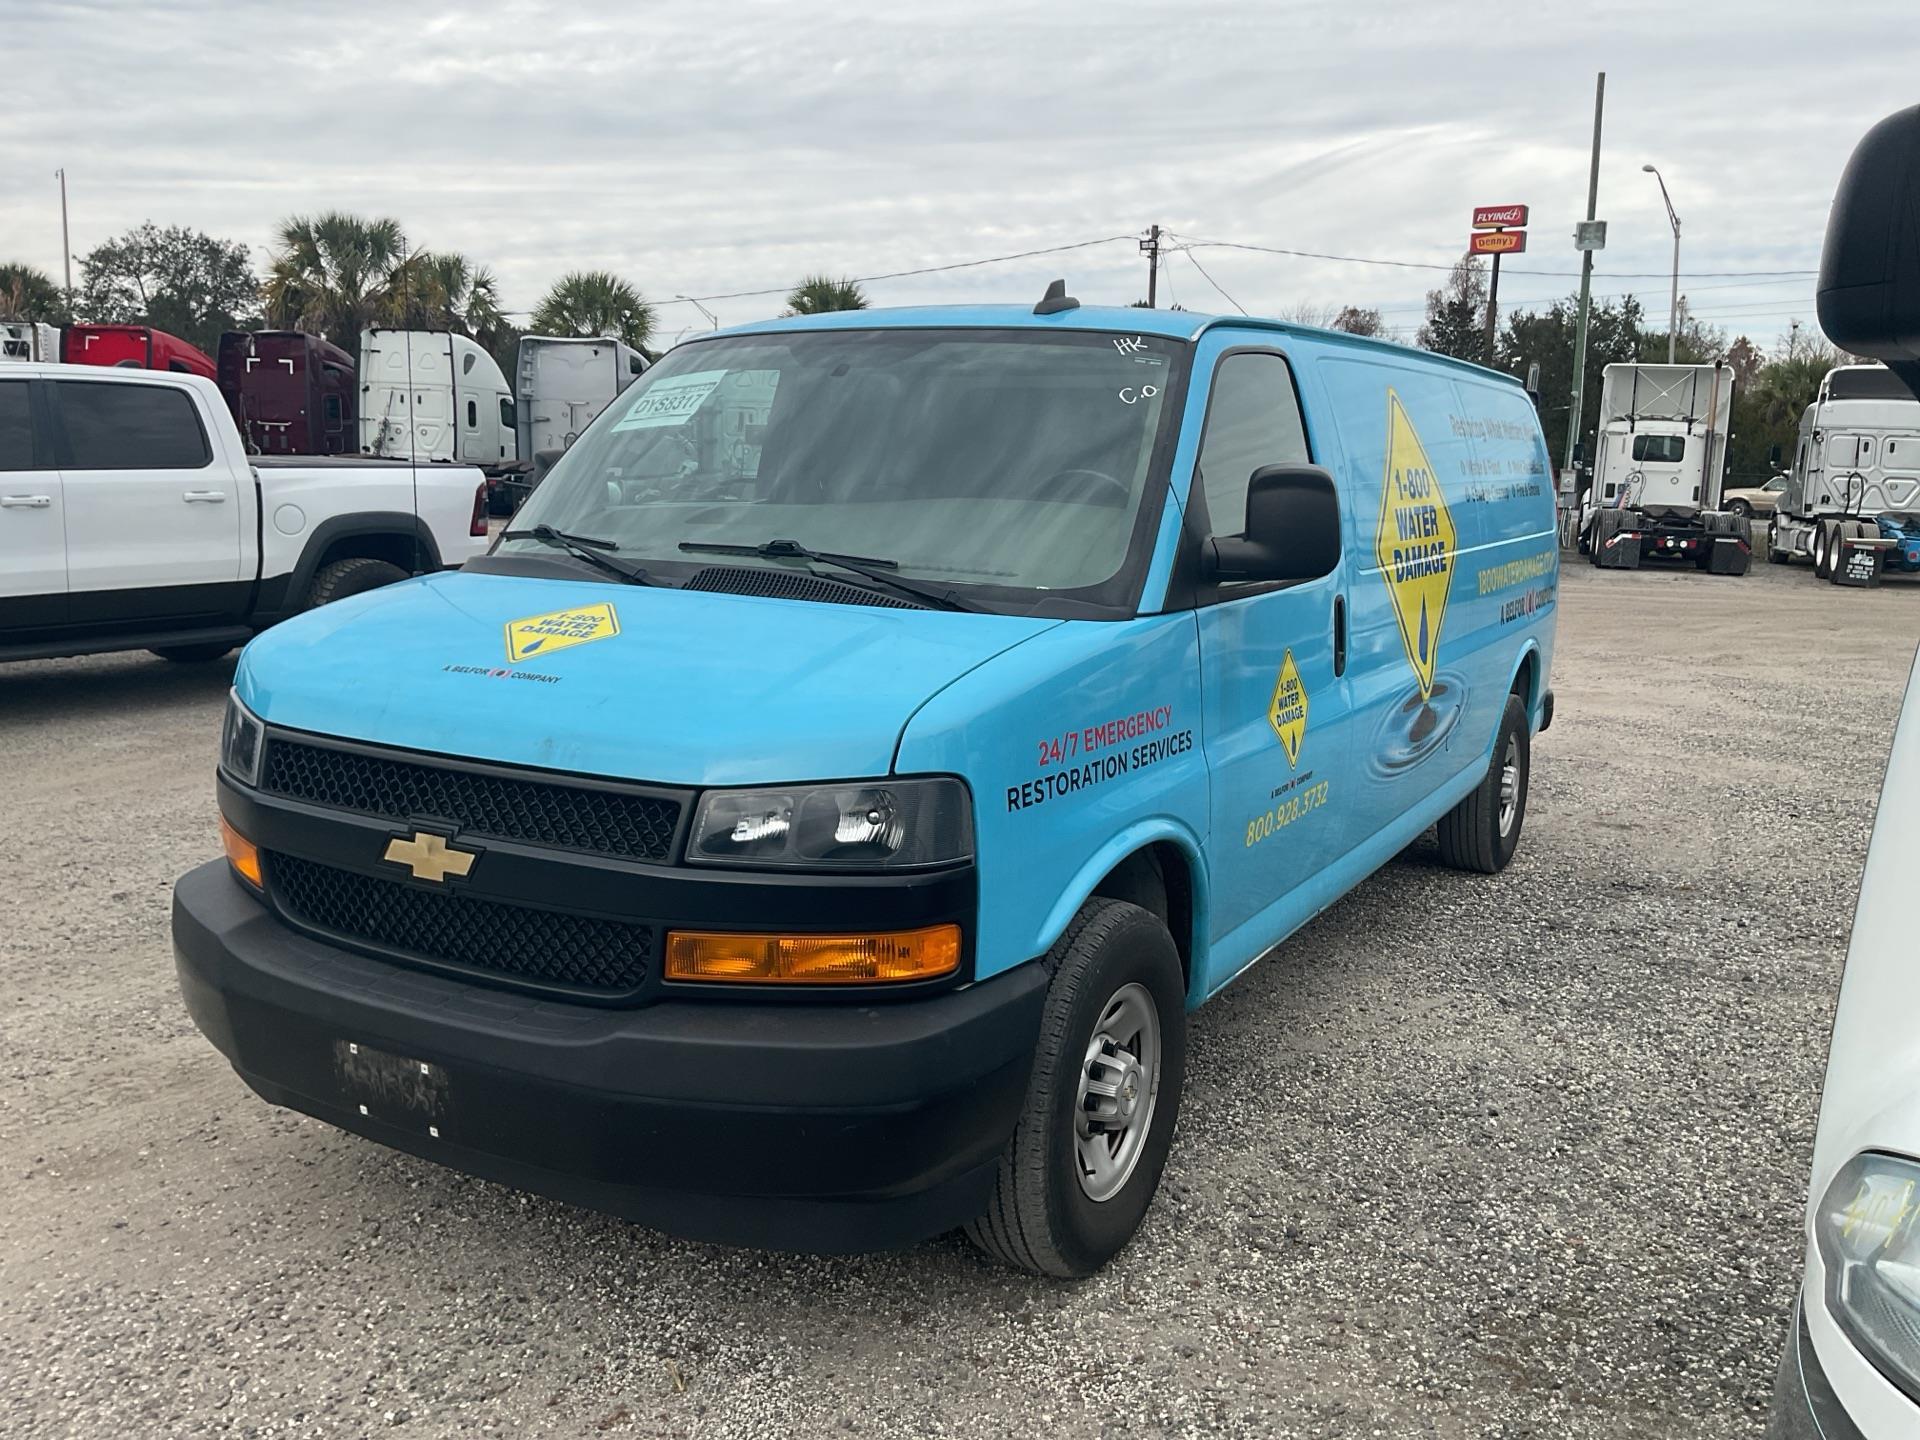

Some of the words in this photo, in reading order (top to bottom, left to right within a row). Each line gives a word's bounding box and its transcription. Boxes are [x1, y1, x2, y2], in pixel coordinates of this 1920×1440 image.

[1477, 212, 1511, 222] FLYING
[1478, 236, 1512, 247] Denny's
[634, 393, 705, 414] DYS8317
[1395, 468, 1431, 500] 1-800
[1395, 505, 1439, 541] WATER
[1393, 541, 1447, 583] DAMAGE
[540, 619, 600, 630] WATER
[558, 613, 606, 623] 1-800
[519, 625, 597, 639] DAMAGE
[451, 665, 490, 676] BELFOR
[511, 671, 563, 685] COMPANY
[1281, 678, 1298, 694] 1-800
[1278, 692, 1299, 710] WATER
[1276, 705, 1304, 727] DAMAGE
[1039, 733, 1079, 766] 24/7
[1084, 705, 1172, 752] EMERGENCY
[1007, 751, 1128, 813] RESTORATION
[1132, 730, 1193, 770] SERVICES
[1246, 780, 1329, 848] 800.928.3732
